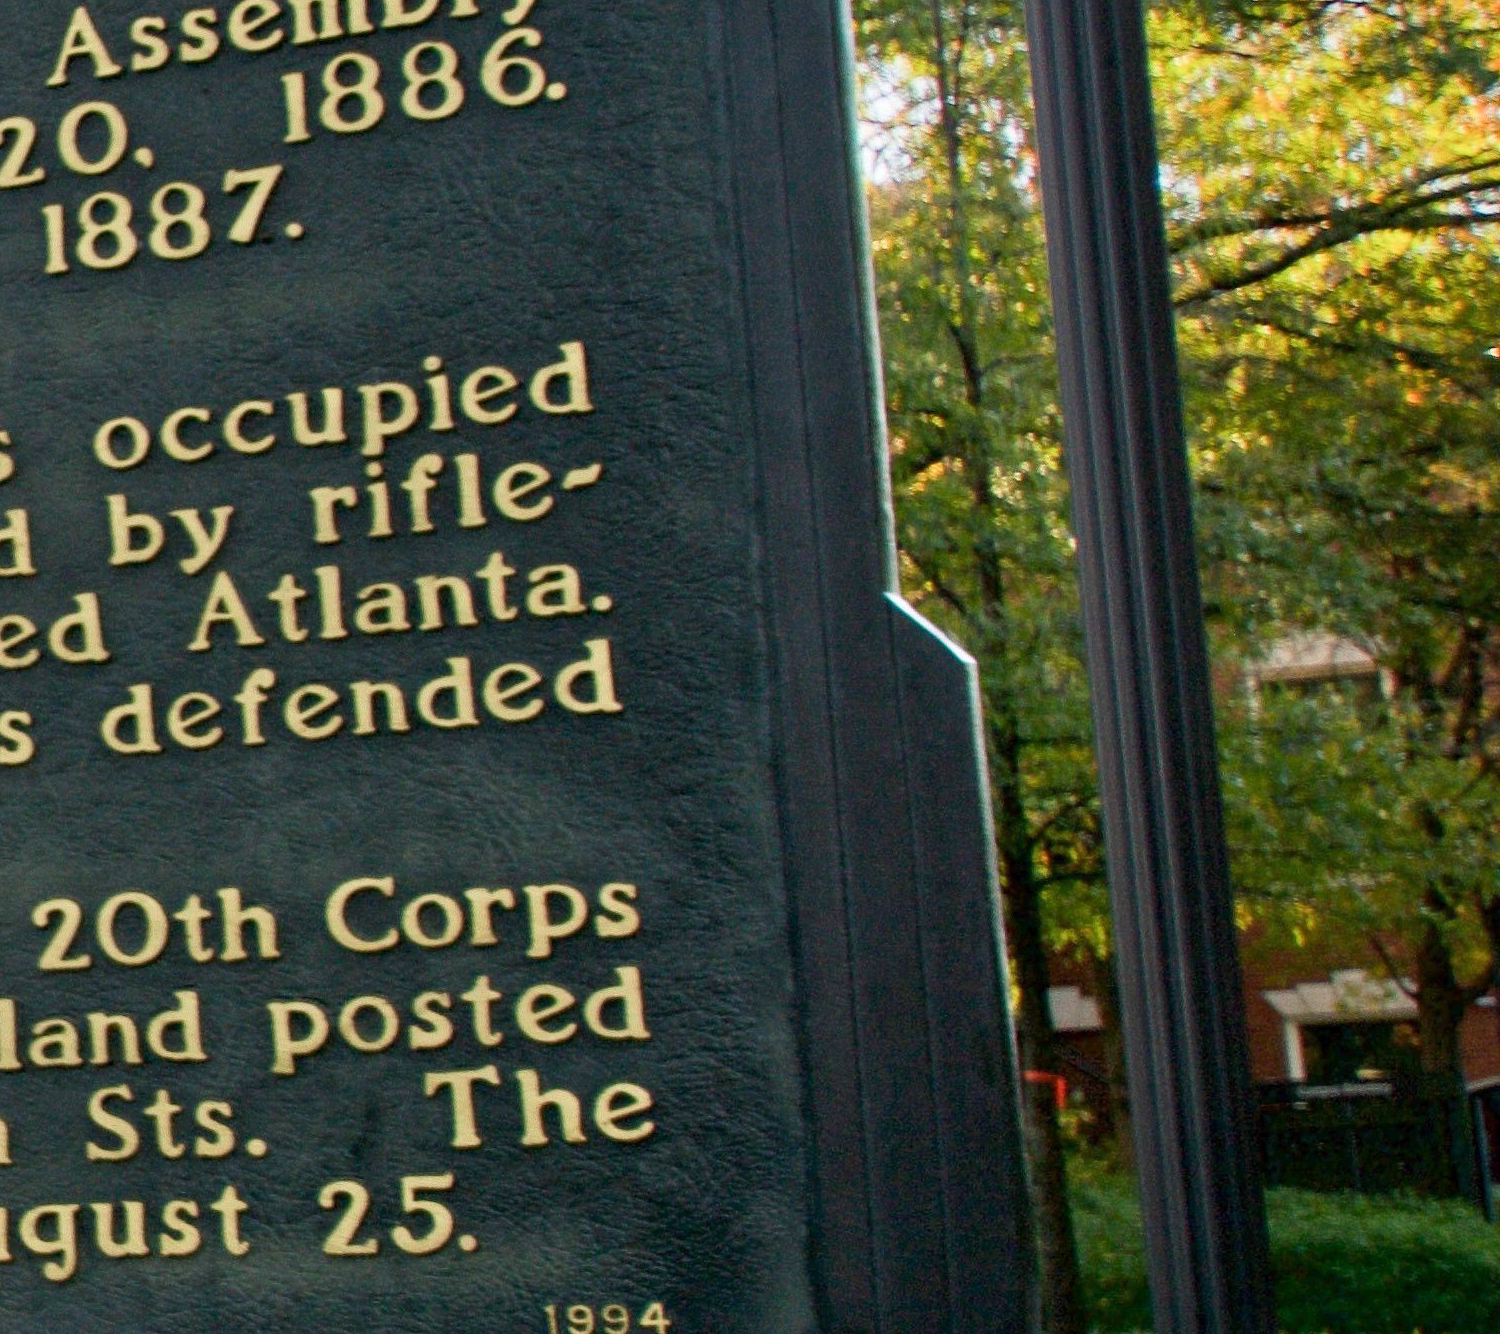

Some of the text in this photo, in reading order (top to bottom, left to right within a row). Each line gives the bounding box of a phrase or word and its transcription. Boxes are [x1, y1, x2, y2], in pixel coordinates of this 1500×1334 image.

[280, 26, 568, 144] 1886.
[41, 163, 304, 275] 1887.
[92, 340, 594, 470] occupied
[106, 492, 235, 575] by
[309, 452, 603, 544] rifle-
[186, 551, 614, 652] Atlanta.
[100, 637, 624, 755] defended
[30, 886, 281, 971] 20th
[324, 875, 641, 959] Corps
[266, 964, 652, 1075] posted
[85, 1083, 269, 1161] Sts.
[424, 1063, 656, 1149] The
[318, 1172, 478, 1256] 25.
